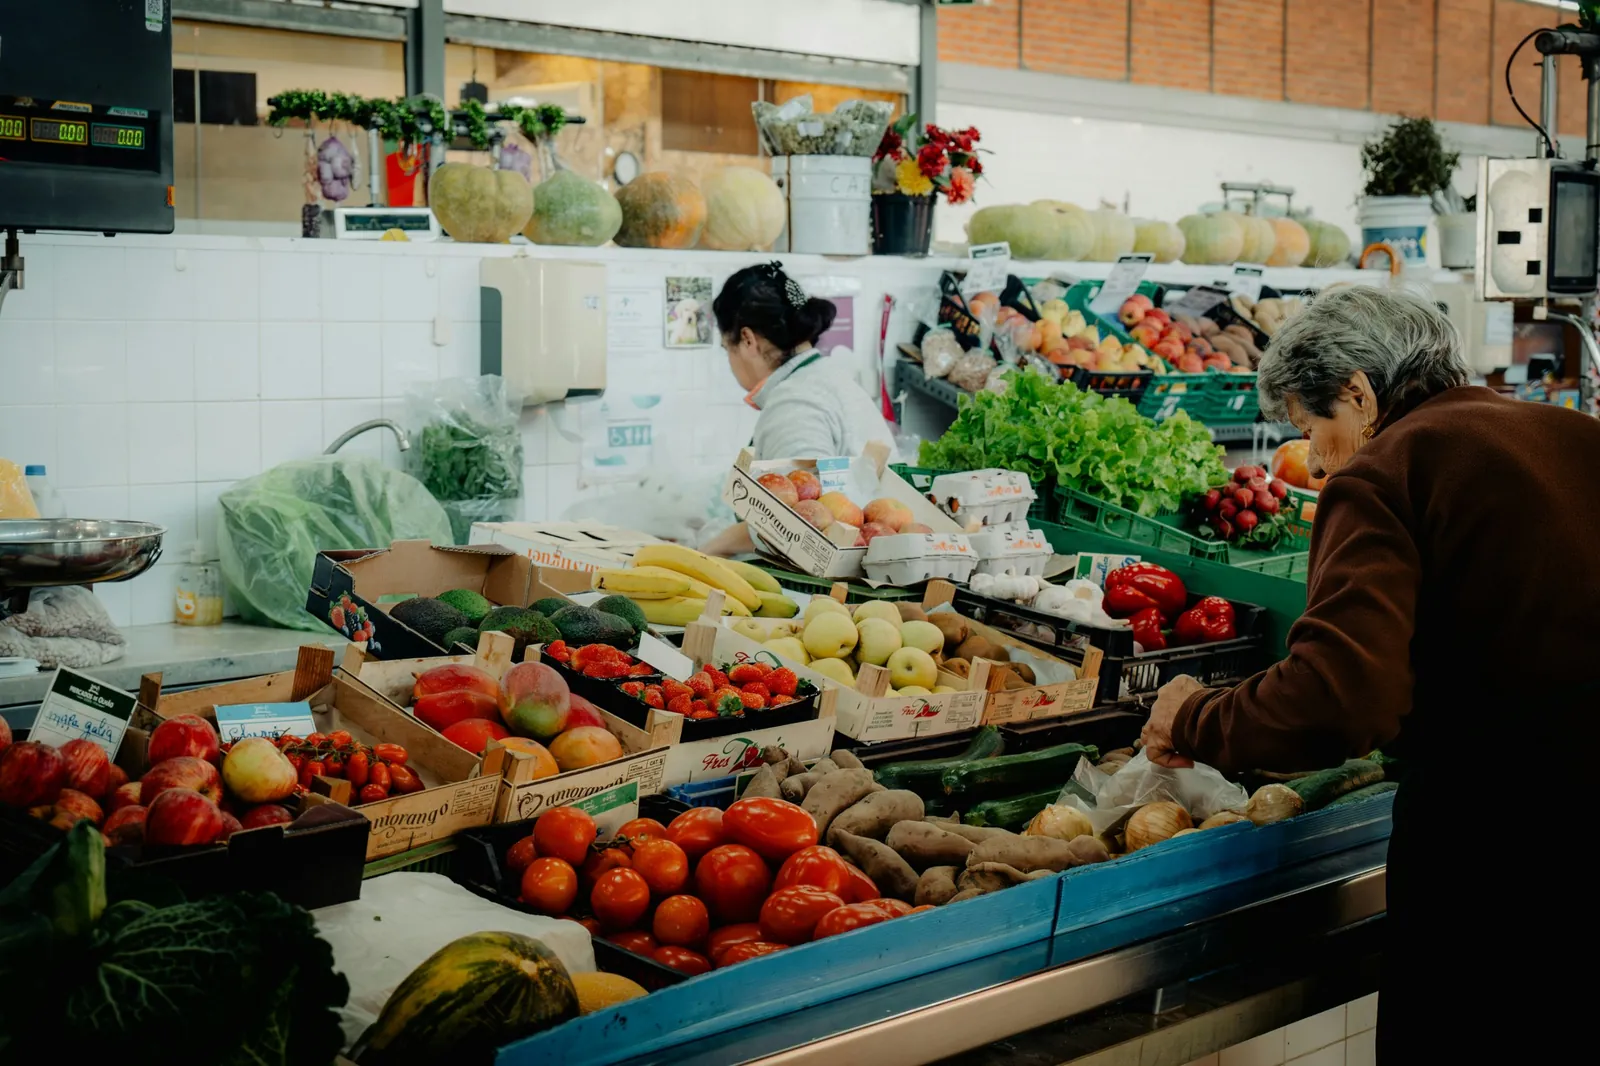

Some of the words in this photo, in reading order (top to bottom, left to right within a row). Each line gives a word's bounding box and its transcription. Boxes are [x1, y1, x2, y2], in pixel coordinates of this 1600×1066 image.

[59, 123, 85, 142] 0.00
[117, 129, 142, 146] 0.00
[702, 753, 731, 772] Fres
[373, 802, 448, 831] morango
